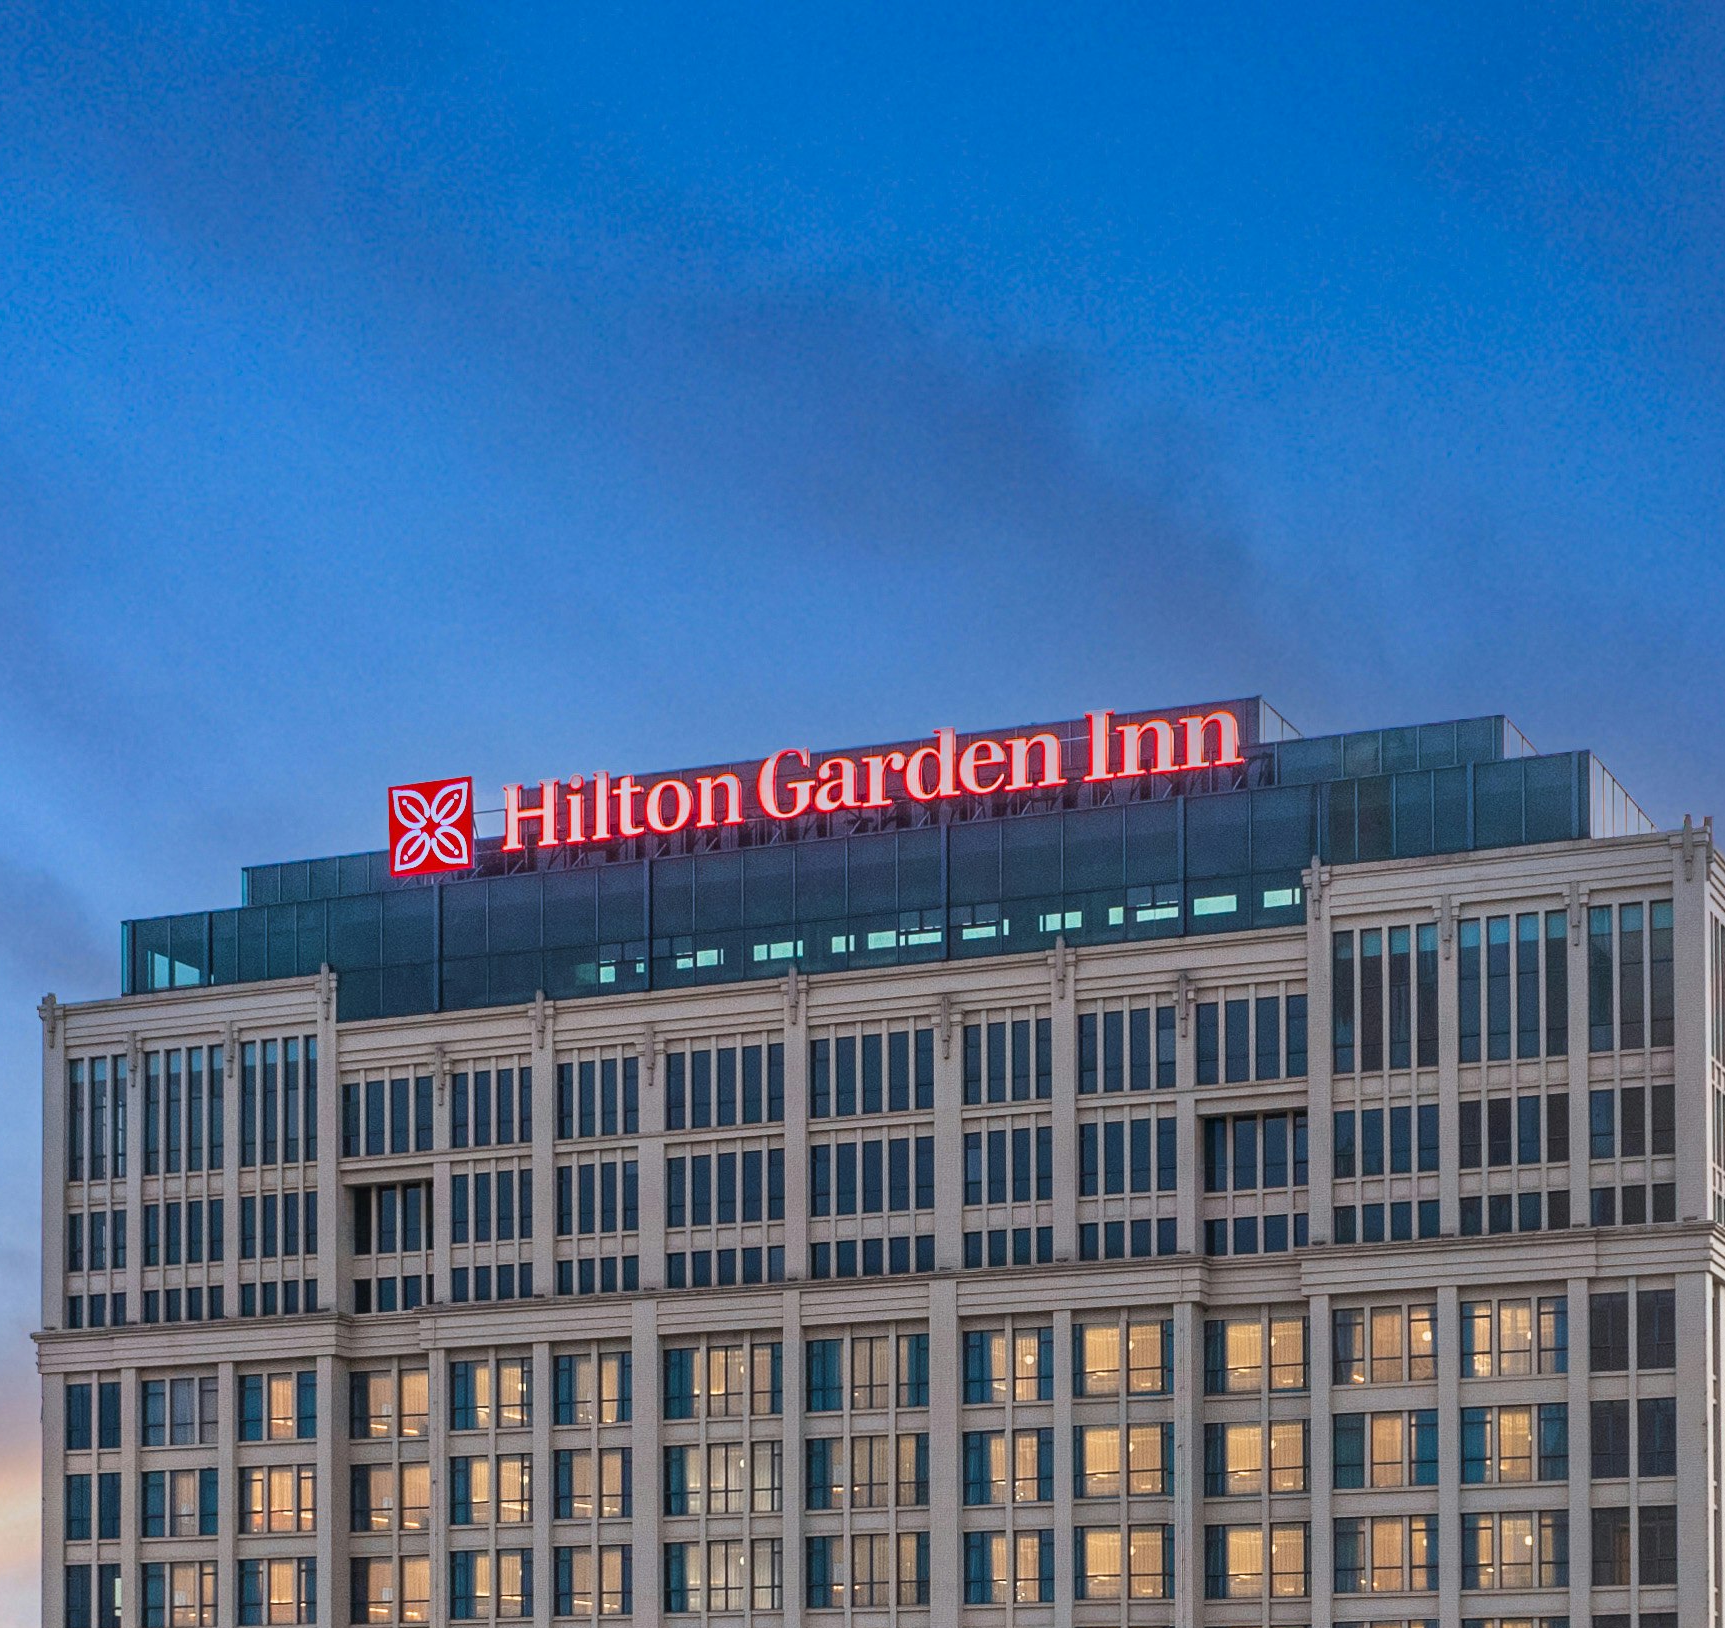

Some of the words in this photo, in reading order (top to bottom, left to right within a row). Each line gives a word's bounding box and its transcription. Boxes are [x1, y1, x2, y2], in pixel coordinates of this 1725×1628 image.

[501, 769, 745, 853] Hilton
[756, 727, 1068, 820] Garden
[1083, 709, 1245, 783] Inn
